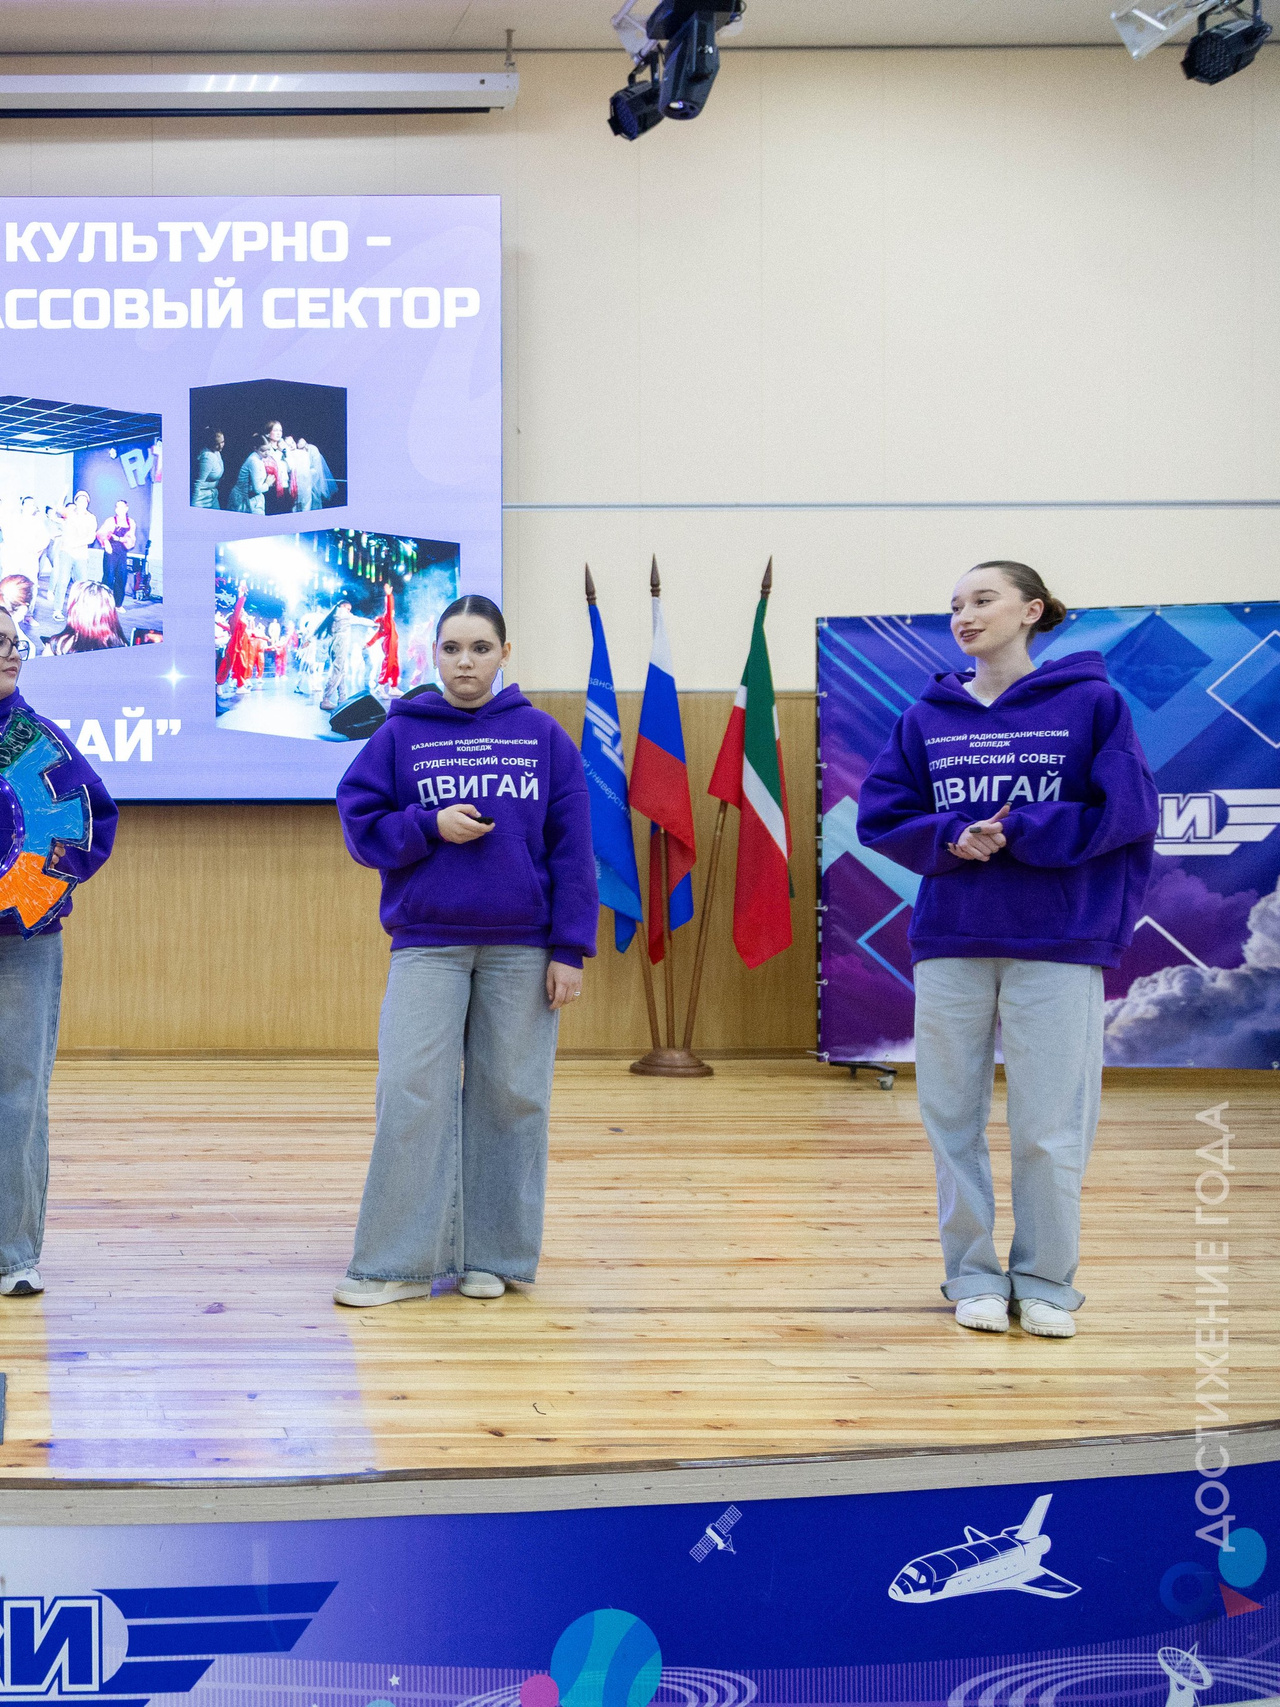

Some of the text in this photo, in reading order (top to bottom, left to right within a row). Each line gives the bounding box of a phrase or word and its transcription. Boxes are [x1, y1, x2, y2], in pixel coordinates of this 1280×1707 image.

[5, 220, 349, 263] КУЛЬТУРНО
[262, 286, 481, 330] СЕКТОР
[411, 737, 538, 751] КАЗАНСКИЙ РАДИОМЕХАНИЧЕСКИЙ
[969, 730, 1069, 741] РАДИОМЕХАНИЧЕСКИЙ
[969, 740, 1011, 748] КОЛЛЕДЖ
[456, 744, 492, 752] КОЛЛЕДЖ
[413, 755, 539, 772] СТУДЕНЧЕСКИЙ СОВЕТ
[928, 752, 1066, 772] СТУДЕНЧЕСКИЙ СОВЕТ
[417, 771, 539, 808] ДВИГАЙ
[932, 770, 1063, 813] ДВИГАЙ
[1157, 792, 1216, 843] И
